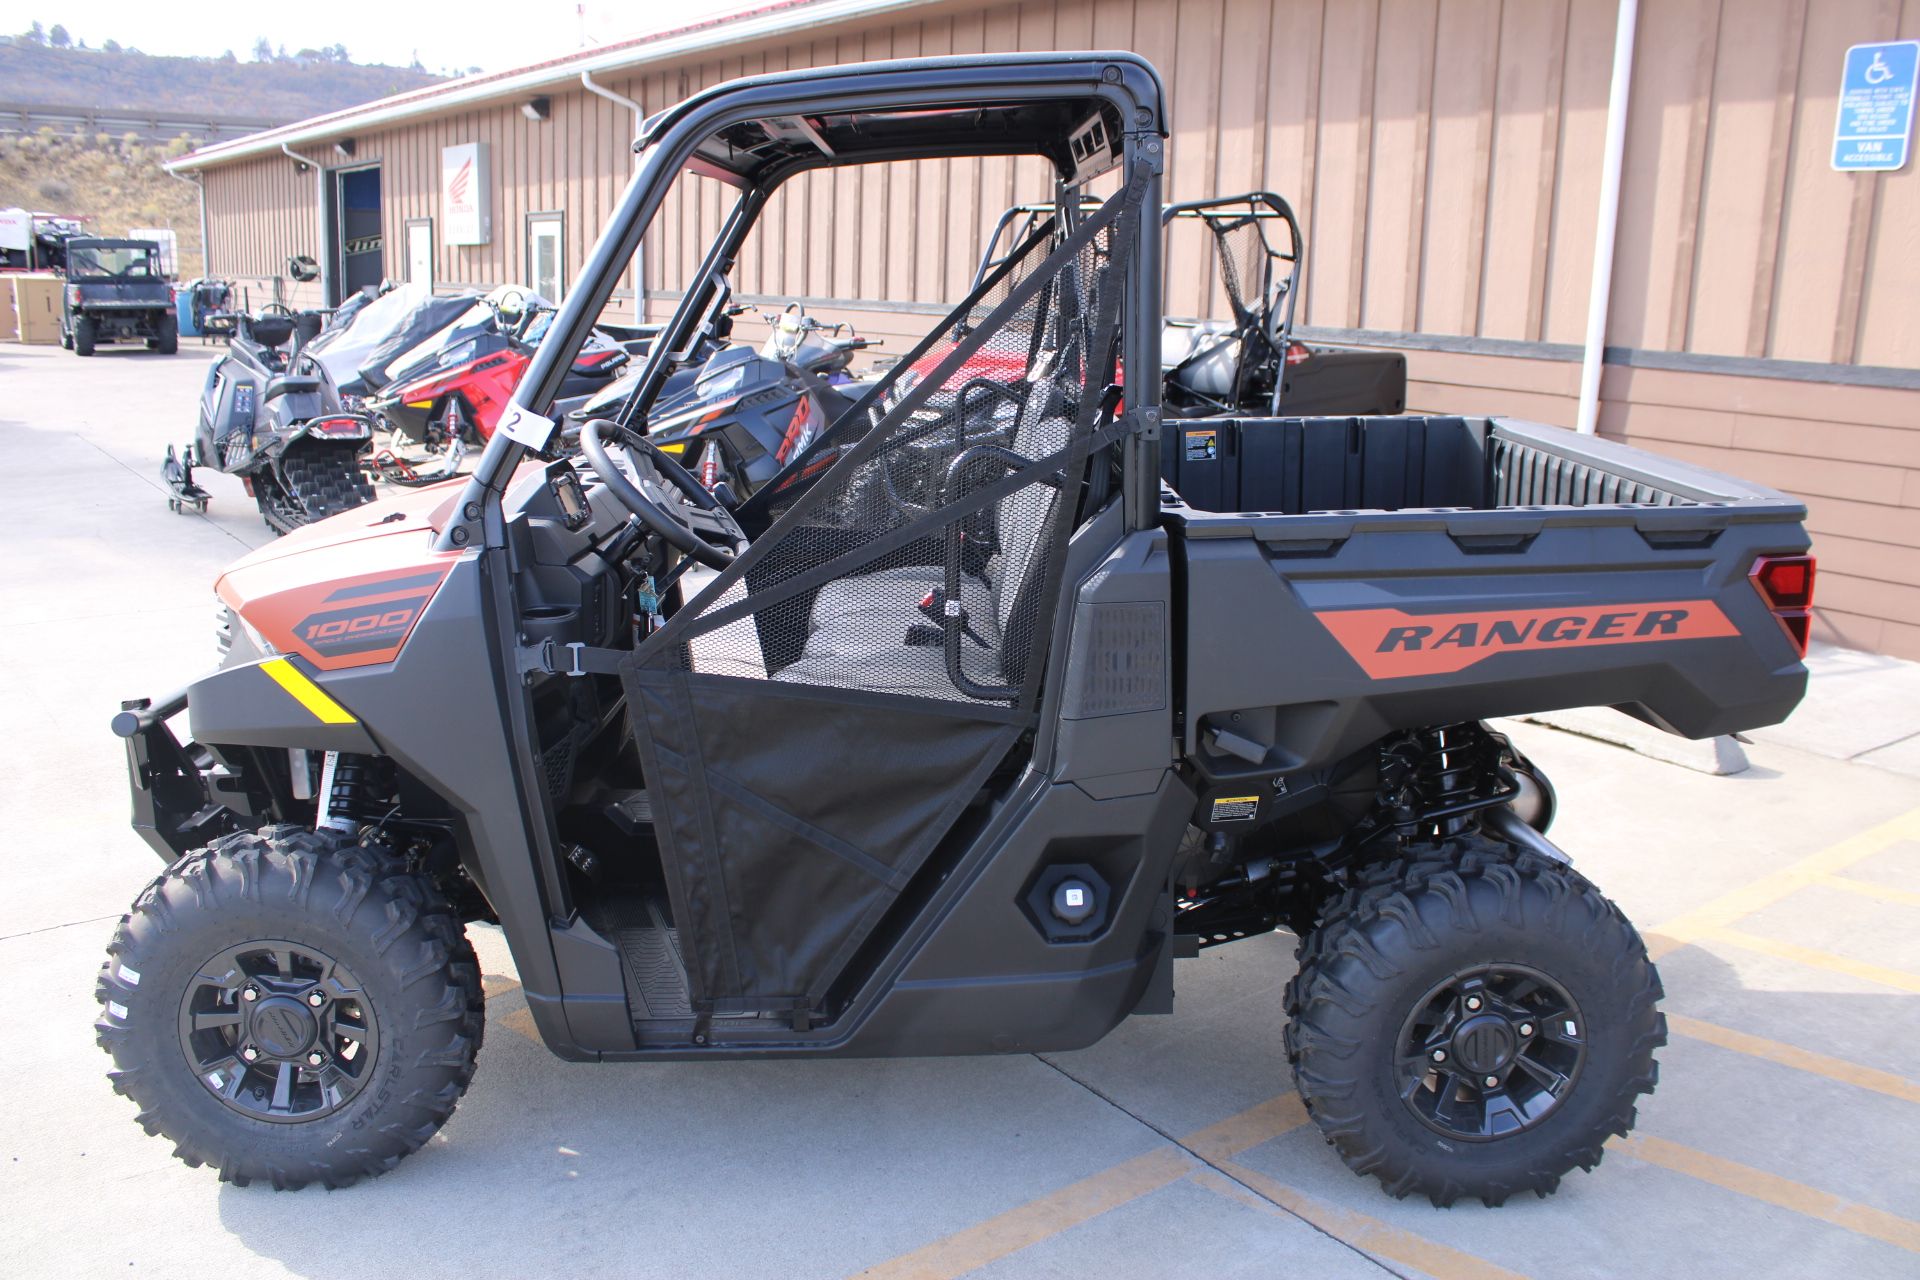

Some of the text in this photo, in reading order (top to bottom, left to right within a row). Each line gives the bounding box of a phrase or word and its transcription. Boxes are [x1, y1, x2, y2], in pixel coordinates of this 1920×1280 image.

[1842, 152, 1895, 162] ACCESSIBLE
[1857, 142, 1883, 153] VAN
[600, 353, 626, 370] POLARIS
[506, 412, 522, 433] 2
[306, 609, 413, 640] 1000
[1374, 609, 1690, 653] RANGER
